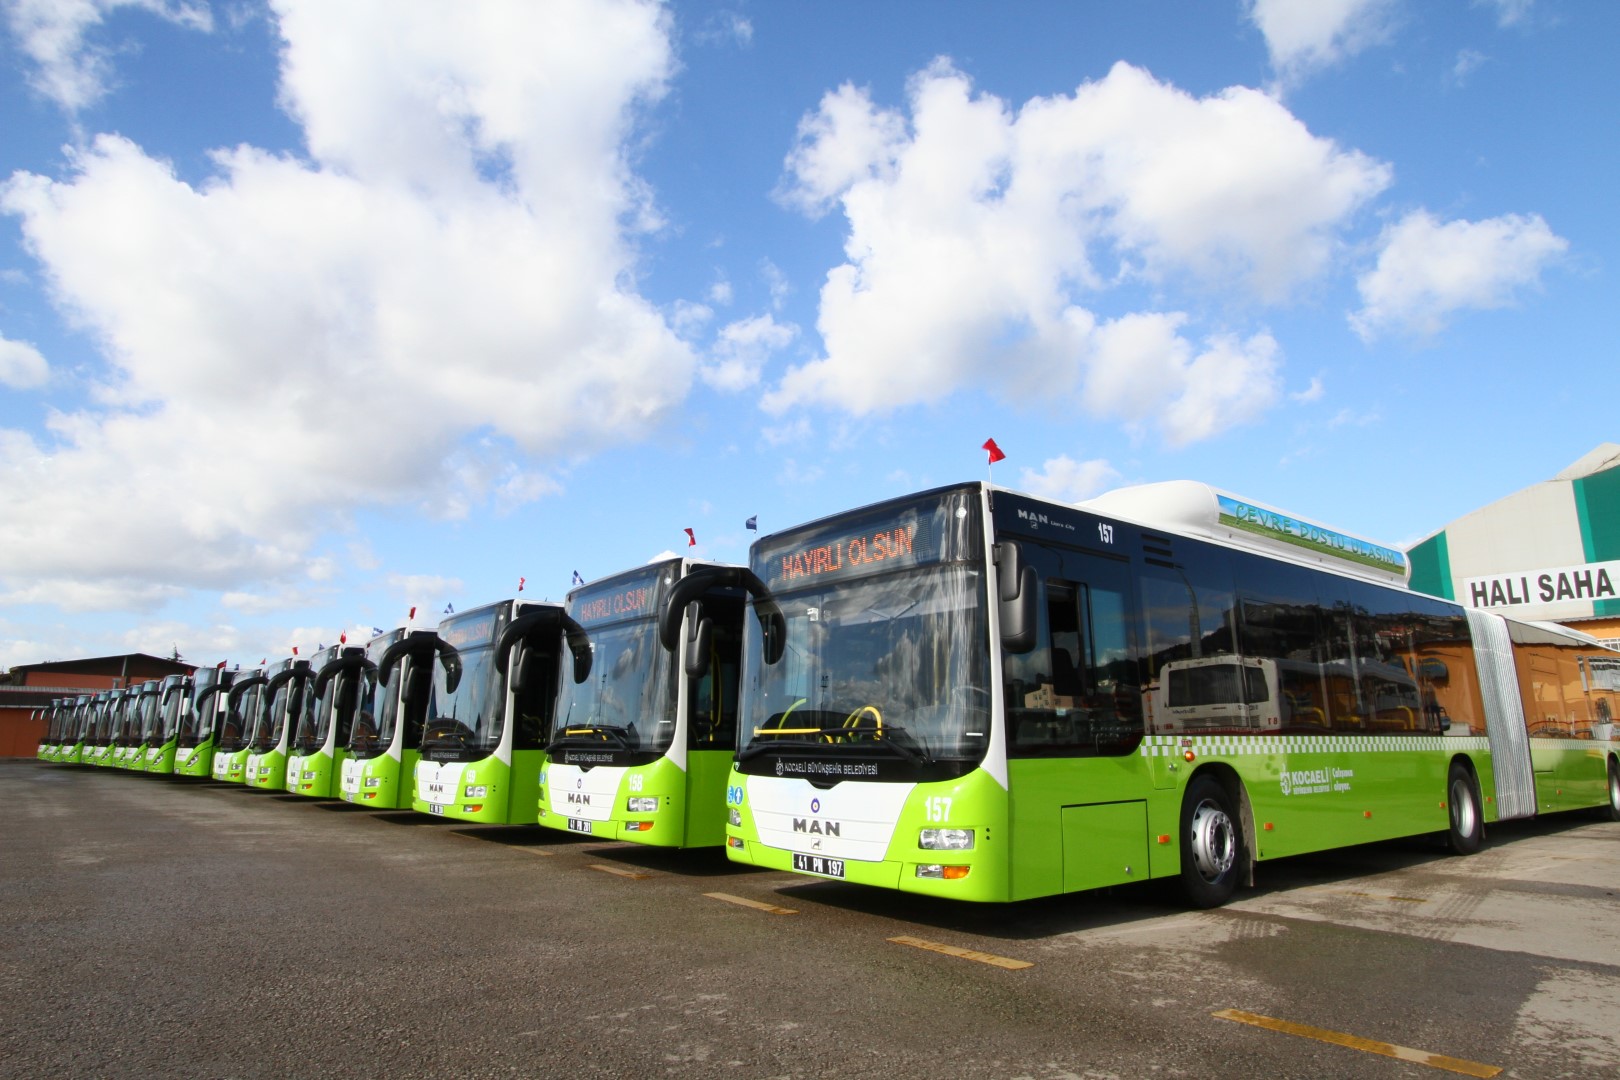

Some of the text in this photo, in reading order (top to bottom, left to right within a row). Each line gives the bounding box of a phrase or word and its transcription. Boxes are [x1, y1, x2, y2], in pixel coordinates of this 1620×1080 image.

[1017, 508, 1049, 524] MAN
[1234, 504, 1292, 534] ÇEVRE
[1299, 524, 1345, 549] DOSTU
[1098, 522, 1113, 544] 157
[782, 526, 912, 580] HAYIRLI OLSUN
[1470, 568, 1616, 608] HALI SAHA
[613, 587, 647, 614] OLSUN
[785, 762, 807, 773] KOCAELİ
[843, 763, 878, 775] BELEDİYESİ
[1292, 767, 1329, 785] KOCAELİ
[629, 774, 643, 792] 158
[567, 793, 590, 805] MAN
[925, 796, 952, 822] 157
[793, 817, 840, 837] MAN
[798, 855, 842, 876] 41 PN 197
